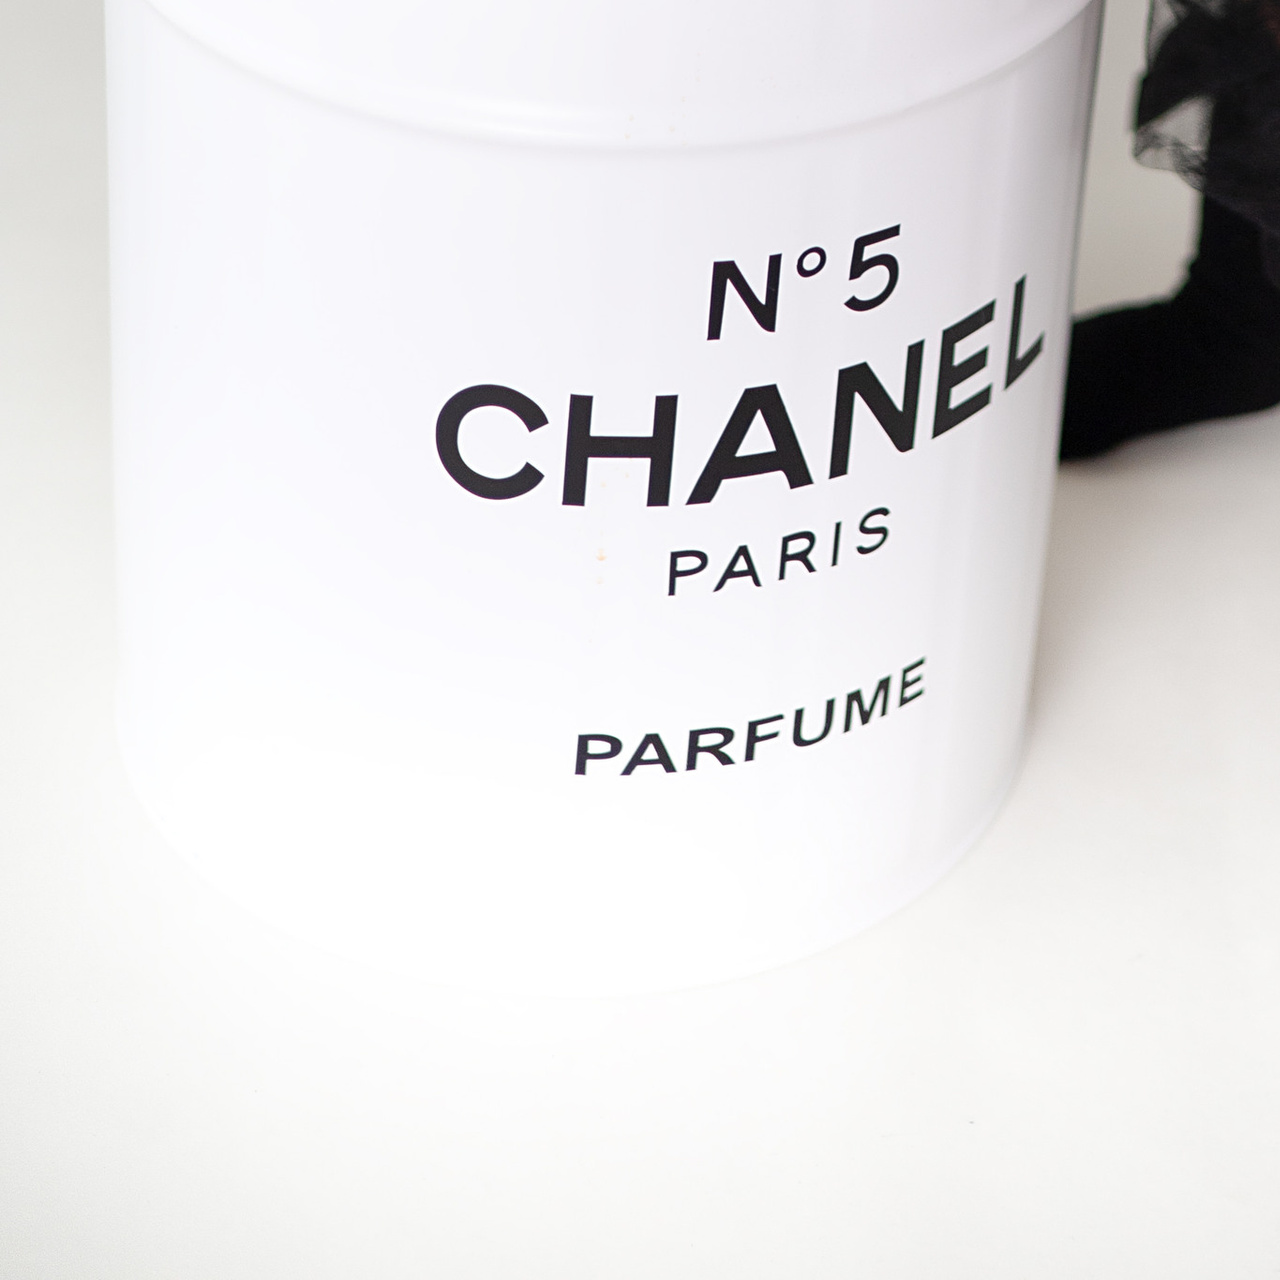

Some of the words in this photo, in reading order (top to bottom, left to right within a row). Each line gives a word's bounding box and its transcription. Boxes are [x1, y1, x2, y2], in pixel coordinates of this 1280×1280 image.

[434, 274, 1046, 507] CHANEL
[667, 506, 892, 597] PARIS
[573, 656, 927, 777] PARFUME
